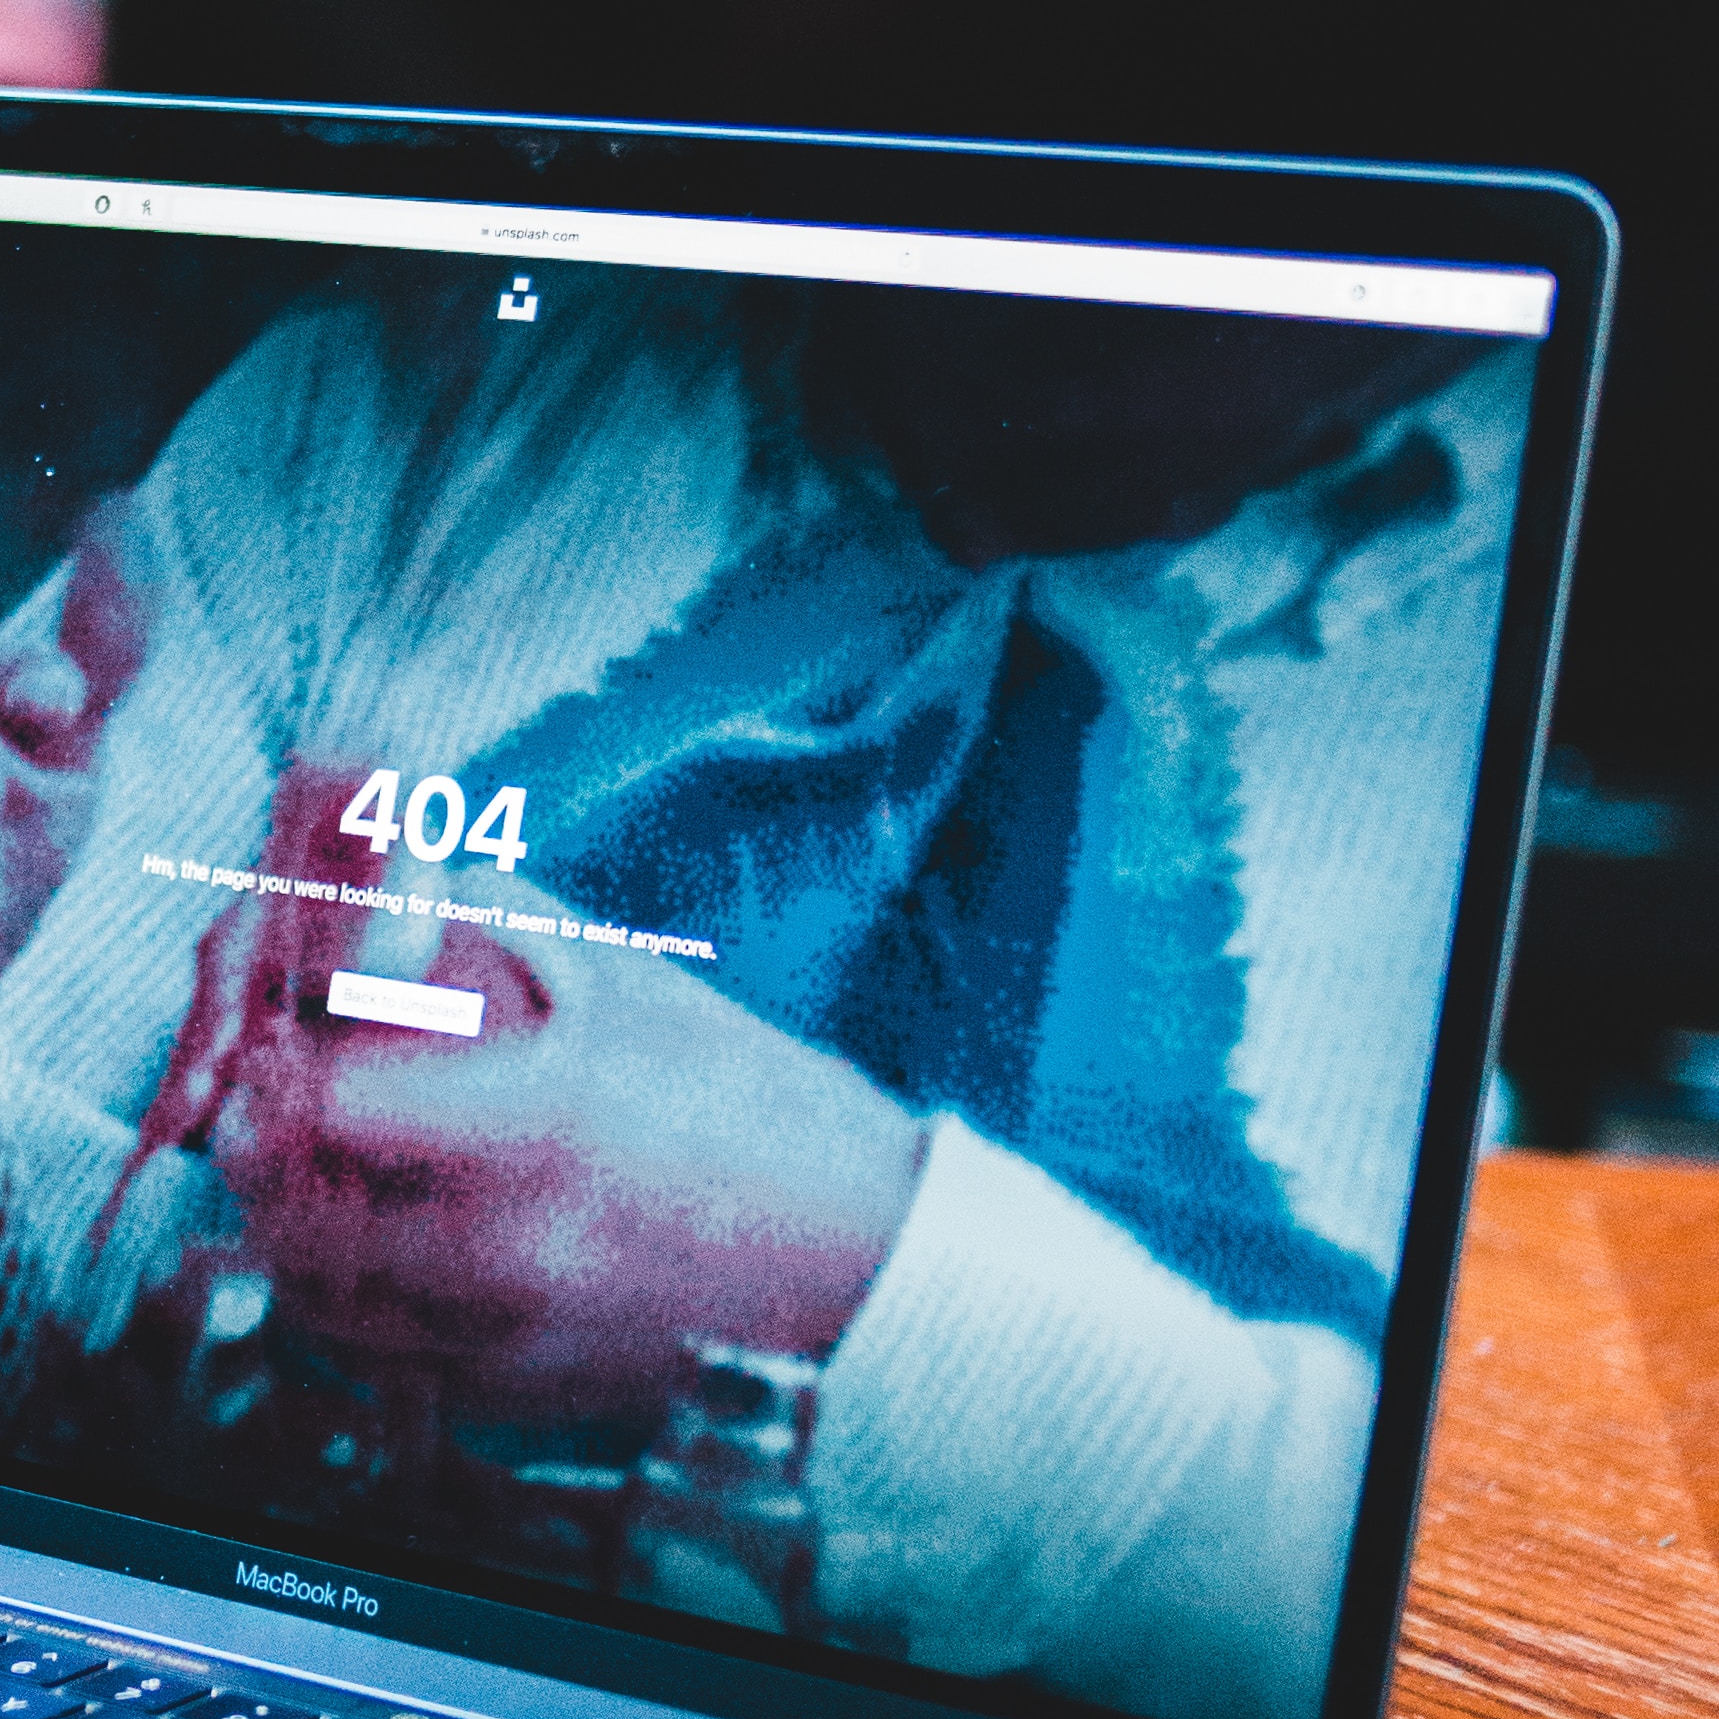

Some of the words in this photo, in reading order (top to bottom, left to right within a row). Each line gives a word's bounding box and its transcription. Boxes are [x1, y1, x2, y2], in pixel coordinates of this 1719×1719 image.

[338, 768, 529, 873] 404
[141, 853, 176, 880] Hm,
[180, 859, 209, 882] the
[210, 866, 255, 892] page
[257, 874, 292, 895] you
[293, 879, 338, 902] were
[339, 882, 405, 916] looking
[406, 892, 435, 915] for
[506, 910, 557, 936] seem
[559, 917, 581, 939] to
[582, 921, 630, 947] exist
[629, 930, 718, 961] anymore.
[343, 987, 377, 1005] Back
[381, 995, 396, 1009] to
[399, 997, 468, 1020] Unsplash
[235, 1561, 338, 1608] MacBook
[341, 1585, 380, 1617] Pro
